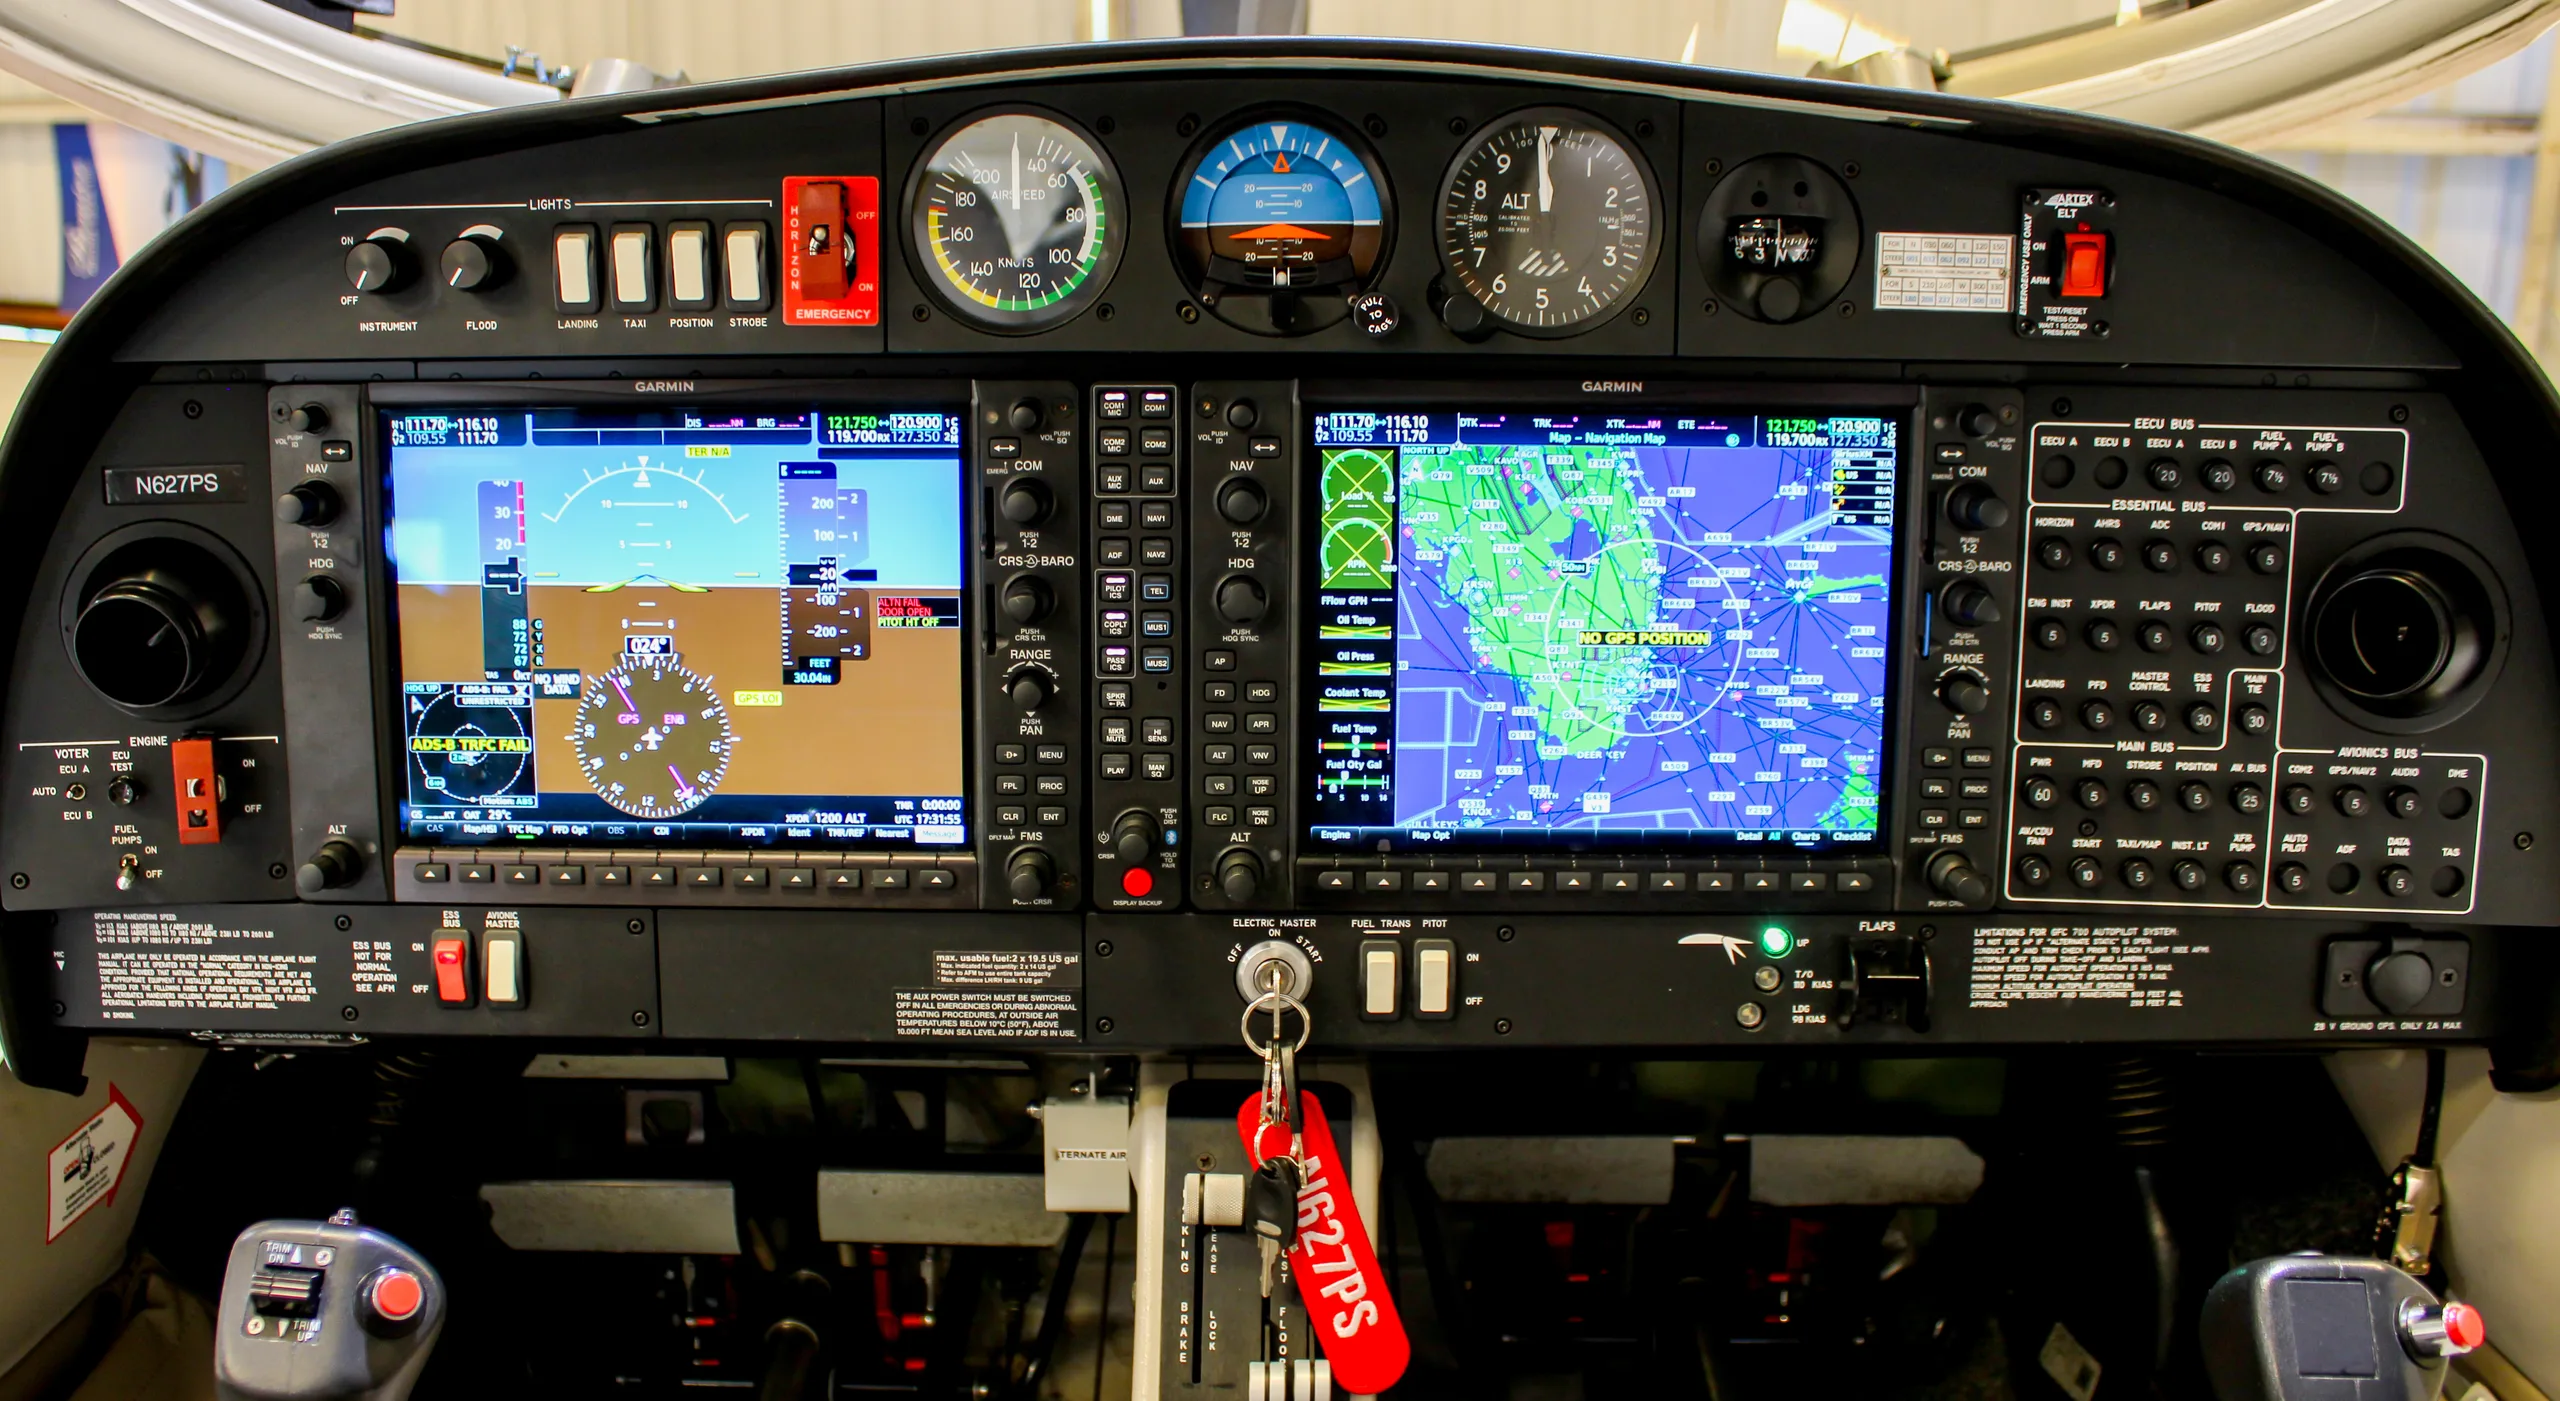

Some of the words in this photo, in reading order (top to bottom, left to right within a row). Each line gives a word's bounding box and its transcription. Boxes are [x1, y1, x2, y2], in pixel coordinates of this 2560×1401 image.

[1028, 159, 1046, 173] 40
[973, 169, 999, 183] 200
[1048, 173, 1067, 188] 60
[1474, 181, 1487, 199] 8
[529, 199, 571, 210] LIGHTS
[955, 192, 976, 207] 180
[1502, 194, 1530, 211] ALT
[856, 211, 875, 220] OFF
[1066, 208, 1083, 223] 80
[2057, 208, 2077, 219] ELT
[2023, 214, 2032, 238] ONLY
[951, 227, 973, 242] 160
[341, 236, 353, 245] ON
[790, 206, 798, 290] HORIZON
[2022, 239, 2031, 259] USE
[2032, 242, 2046, 251] ON
[1049, 249, 1071, 264] 100
[1603, 247, 1616, 267] 3
[998, 258, 1033, 269] KNOTS
[970, 262, 992, 277] 140
[1019, 274, 1040, 288] 120
[2030, 276, 2050, 285] ARM
[859, 283, 873, 292] ON
[2019, 259, 2030, 316] EMERGENCY
[341, 296, 358, 305] OFF
[1535, 289, 1549, 309] 5
[1361, 297, 1383, 312] PULL
[796, 309, 871, 320] EMERGENCY
[1370, 310, 1382, 319] TO
[360, 322, 417, 331] INSTRUMENT
[466, 321, 497, 331] FLOOD
[558, 320, 598, 329] LANDING
[624, 319, 646, 329] TAXI
[670, 318, 713, 328] POSITION
[730, 318, 767, 327] STROBE
[1368, 318, 1393, 334] CAGE
[635, 381, 693, 392] GARMIN
[1582, 382, 1642, 393] GARMIN
[457, 418, 497, 431] 116.10
[828, 417, 876, 429] 121.750
[892, 417, 939, 429] 120.900
[1386, 416, 1428, 429] 116.10
[1767, 419, 1816, 432] 121.750
[2135, 419, 2165, 429] EECU
[2171, 419, 2194, 430] BUS
[408, 433, 446, 444] 109.55
[891, 431, 940, 443] 127.350
[306, 464, 328, 473] NAV
[1015, 461, 1042, 470] COM
[1230, 462, 1253, 470] NAV
[2214, 472, 2230, 482] 20
[136, 473, 218, 494] N627PS
[2113, 501, 2175, 512] ESSENTIAL
[2182, 502, 2205, 513] BUS
[309, 559, 334, 568] HDG
[1229, 559, 1254, 568] HDG
[878, 598, 899, 607] ALTN
[902, 598, 920, 607] FAIL
[878, 608, 904, 616] DOOR
[907, 608, 931, 616] OPEN
[878, 618, 902, 626] PITOT
[906, 618, 918, 626] HT
[922, 618, 938, 626] OFF
[1337, 615, 1351, 624] Oil
[1353, 616, 1375, 626] Temp
[1579, 632, 1599, 644] NO
[1605, 633, 1636, 644] GPS
[1639, 633, 1709, 645] POSITION
[1010, 650, 1051, 659] RANGE
[810, 659, 830, 668] FEET
[1325, 688, 1358, 697] Coolant
[1361, 689, 1385, 698] Temp
[1020, 726, 1042, 735] PAN
[130, 736, 167, 746] ENGINE
[412, 739, 455, 750] ADS-B
[461, 739, 496, 750] TRFC
[499, 739, 529, 750] FAIL
[2117, 742, 2145, 752] MAIN
[2151, 742, 2174, 753] BUS
[55, 748, 89, 759] VOTER
[112, 751, 130, 760] ECU
[1040, 751, 1062, 759] MENU
[2338, 748, 2388, 758] AVIONICS
[2394, 748, 2418, 759] BUS
[111, 762, 133, 771] TEST
[243, 759, 255, 767] ON
[60, 765, 77, 774] ECU
[82, 764, 90, 773] A
[2391, 768, 2419, 777] AUDIO
[1040, 782, 1062, 790] PROC
[33, 787, 56, 796] AUTO
[2035, 788, 2050, 801] 60
[245, 804, 261, 813] OFF
[64, 811, 80, 820] ECU
[86, 811, 92, 819] B
[115, 825, 138, 834] FUEL
[328, 825, 347, 834] ALT
[112, 835, 142, 845] PUMPS
[1021, 832, 1042, 840] FMS
[1230, 833, 1250, 841] ALT
[1321, 831, 1350, 840] Engine
[1792, 832, 1820, 841] Charts
[1833, 832, 1871, 841] Checklist
[145, 846, 157, 854] ON
[146, 870, 163, 879] OFF
[443, 911, 459, 919] ESS
[487, 912, 518, 920] AVIONIC
[485, 920, 519, 928] MASTER
[1233, 919, 1274, 927] ELECTRIC
[1280, 919, 1316, 927] MASTER
[1352, 920, 1374, 928] FUEL
[1381, 920, 1411, 928] TRANS
[1423, 920, 1447, 928] PITOT
[1859, 921, 1896, 932] FLAPS
[353, 941, 369, 950] ESS
[374, 941, 391, 950] BUS
[412, 943, 424, 951] ON
[1796, 939, 1809, 948] UP
[1228, 943, 1243, 963] OFF
[1296, 936, 1323, 963] START
[354, 952, 370, 960] NOT
[375, 952, 391, 961] FOR
[960, 954, 990, 962] usable
[1049, 955, 1062, 963] US
[1064, 955, 1078, 965] gal
[356, 963, 390, 971] NORMAL
[352, 973, 397, 982] OPERATION
[356, 984, 372, 992] SEE
[377, 984, 395, 992] AFM
[412, 985, 429, 993] OFF
[1030, 995, 1071, 1003] SWITCHED
[1466, 997, 1483, 1005] OFF
[1110, 1151, 1126, 1159] AIR
[266, 1243, 290, 1253] TRIM
[1297, 1155, 1378, 1338] N627PS
[269, 1254, 283, 1264] DN
[293, 1320, 320, 1332] TRIM
[297, 1332, 313, 1342] UP
